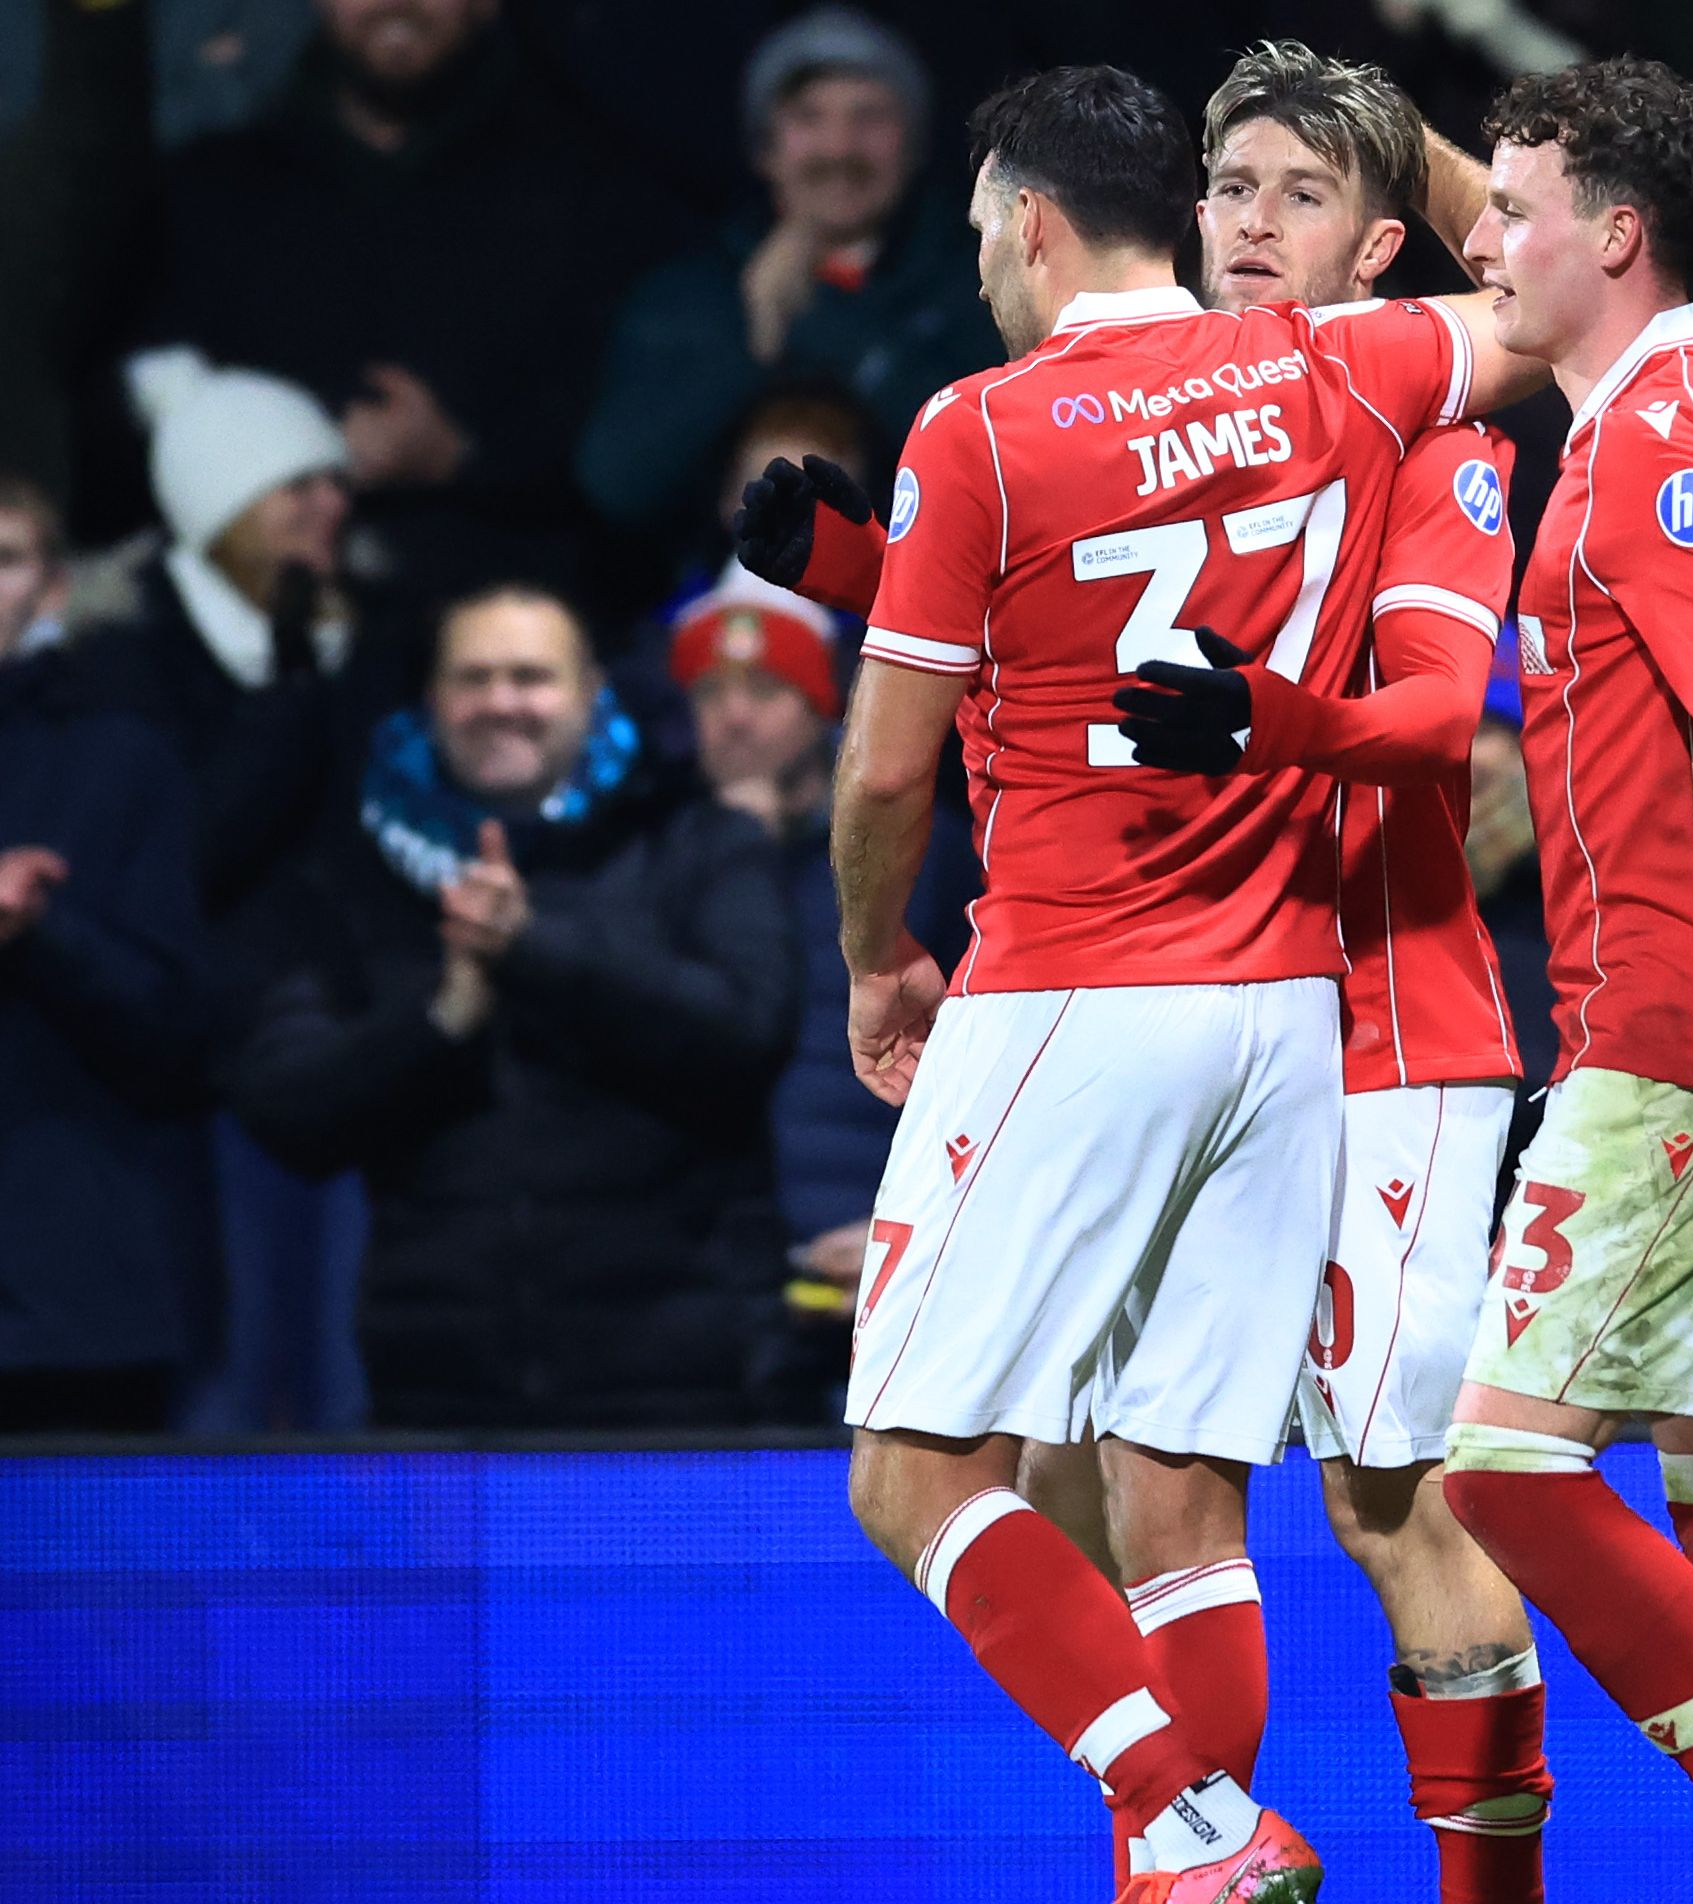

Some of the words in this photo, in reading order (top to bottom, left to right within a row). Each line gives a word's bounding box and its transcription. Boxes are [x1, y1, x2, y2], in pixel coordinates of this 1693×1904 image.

[1107, 377, 1214, 422] Meta
[1211, 349, 1310, 398] Quest
[1127, 404, 1292, 497] JAMES
[1463, 464, 1501, 529] hp
[857, 1218, 914, 1329] 7
[1488, 1180, 1587, 1294] 3
